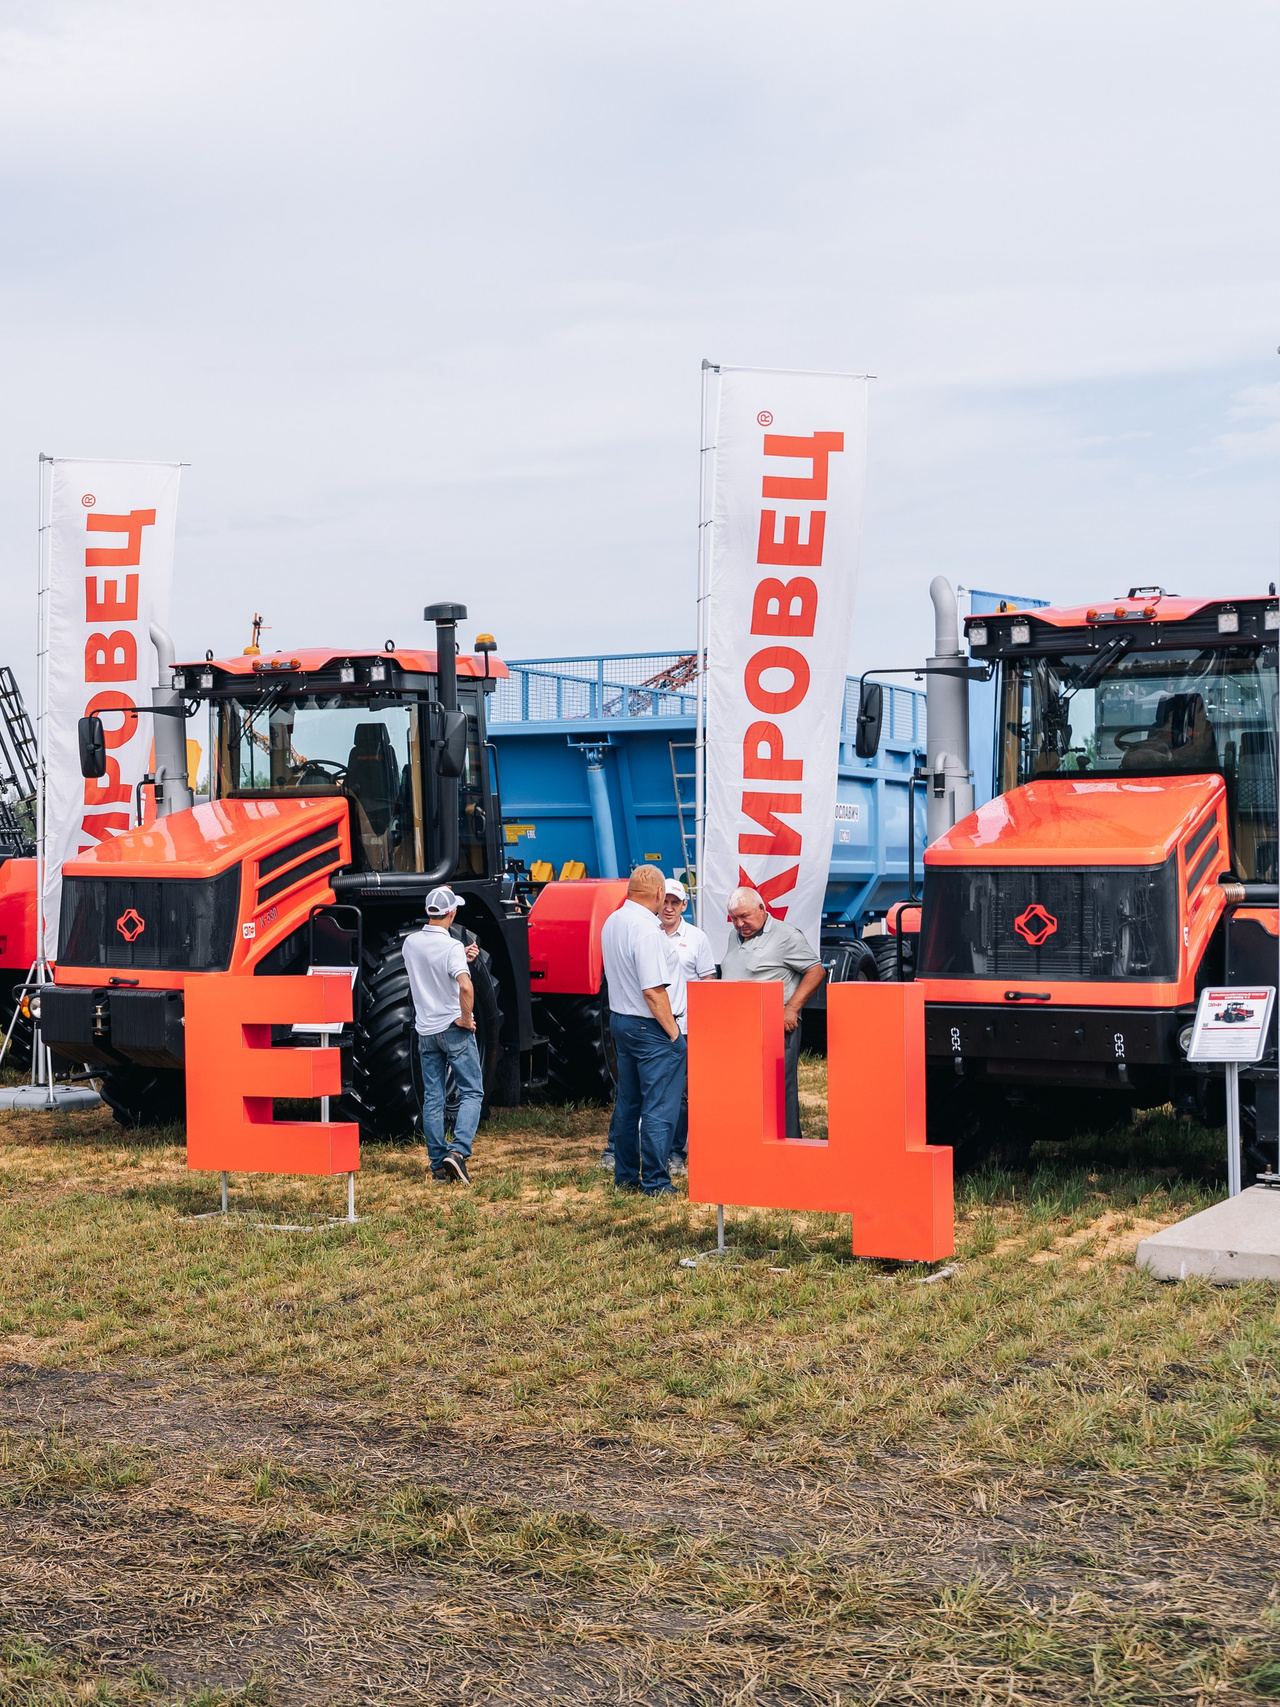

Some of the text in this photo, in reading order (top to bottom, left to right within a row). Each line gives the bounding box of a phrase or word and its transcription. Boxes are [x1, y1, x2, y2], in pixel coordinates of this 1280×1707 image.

[78, 508, 156, 854] ИРОВЕЦ
[727, 432, 845, 923] КИРОВЕЦ
[835, 804, 859, 820] ОСЛАВИЧ
